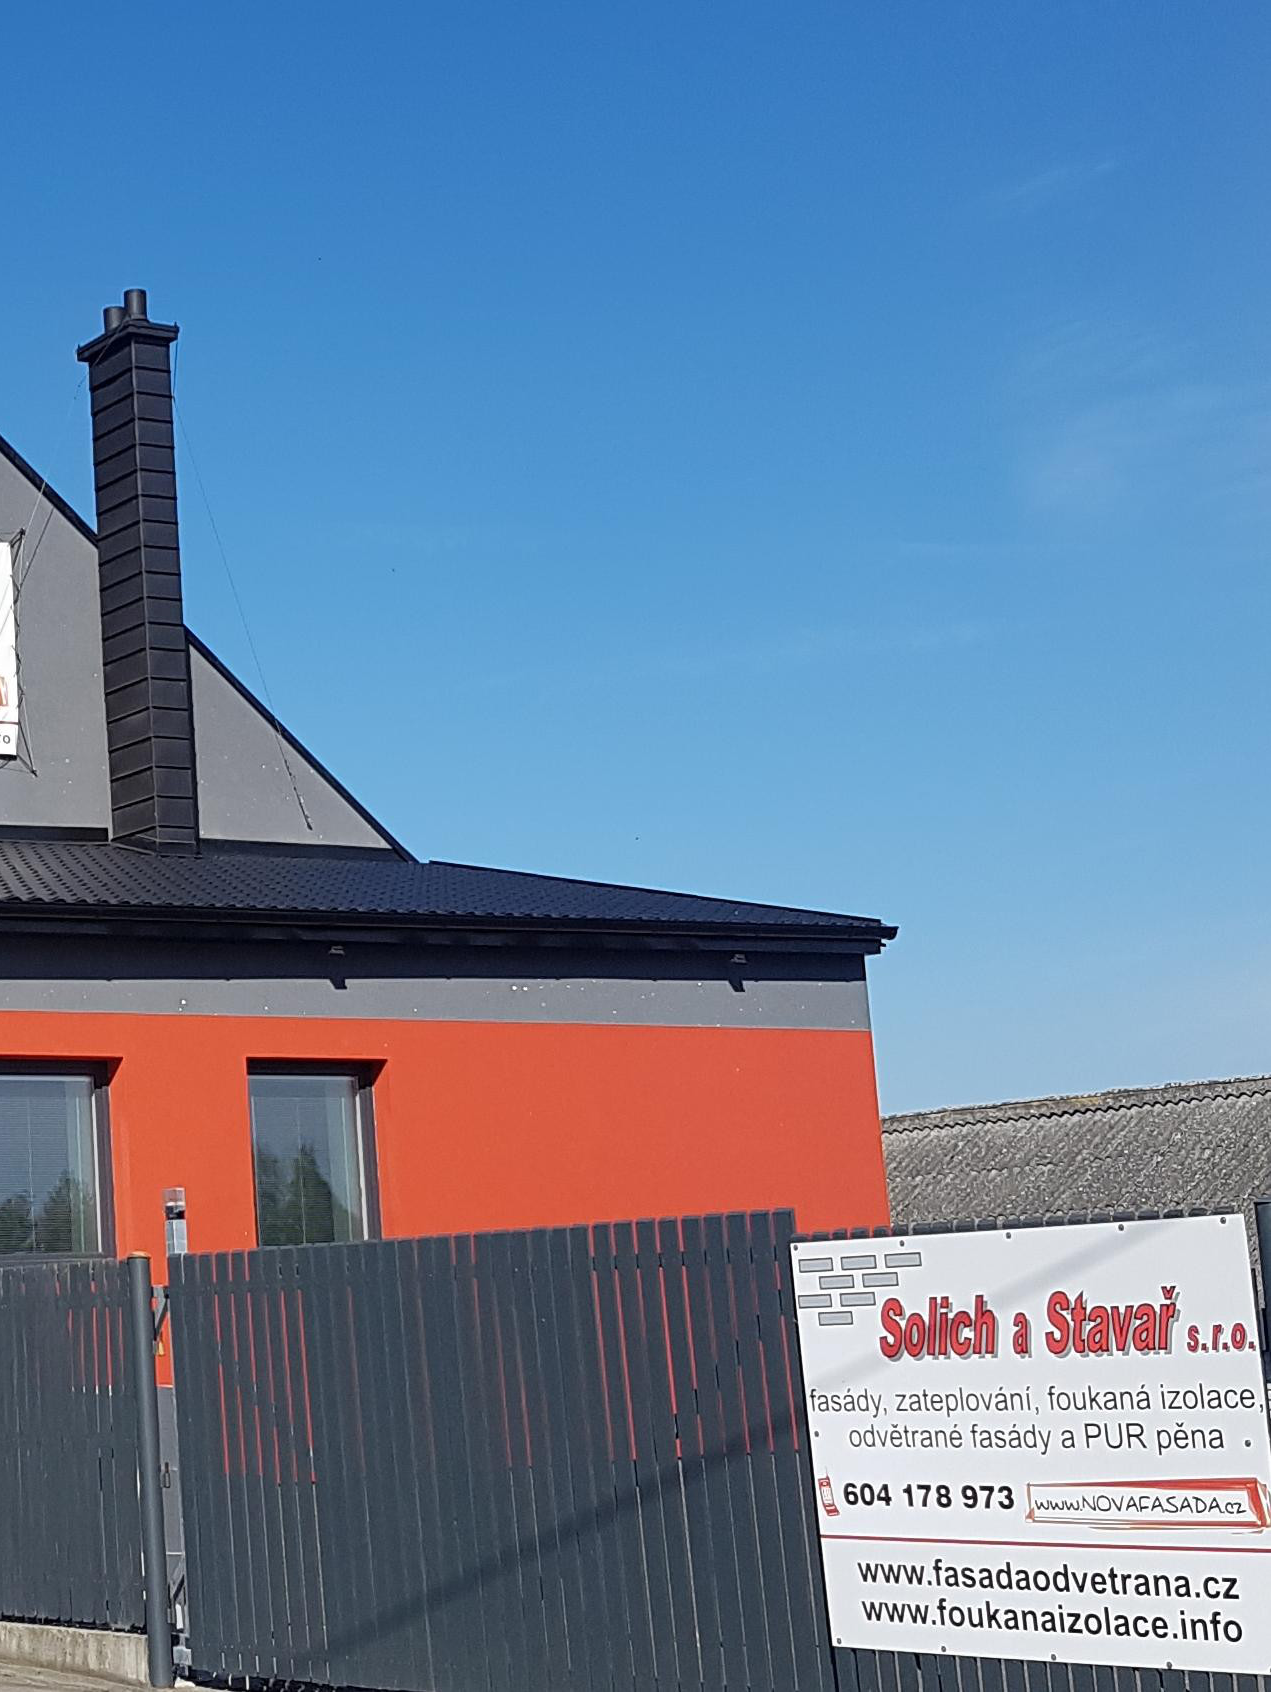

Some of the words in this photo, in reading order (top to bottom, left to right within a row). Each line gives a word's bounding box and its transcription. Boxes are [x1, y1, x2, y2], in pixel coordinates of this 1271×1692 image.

[879, 1295, 996, 1358] Solich
[1013, 1312, 1029, 1355] a
[1045, 1285, 1179, 1357] Stavař
[1186, 1322, 1256, 1352] s.r.o.
[810, 1389, 888, 1418] fasády,
[895, 1387, 1041, 1417] zateplování,
[1047, 1386, 1151, 1411] foukaná
[1159, 1383, 1264, 1413] izolace,
[849, 1423, 963, 1449] odvětrané
[970, 1426, 1052, 1455] fasády
[1060, 1431, 1076, 1449] a
[1085, 1424, 1147, 1449] PUR
[1156, 1423, 1224, 1455] pěna
[843, 1483, 892, 1506] 604
[902, 1483, 952, 1508] 178
[960, 1485, 1015, 1509] 973
[1035, 1495, 1247, 1514] www.NOVAFASADA.cz
[857, 1560, 1240, 1600] www.fasadaodvetrana.cz
[861, 1598, 1244, 1643] www.foukanaizolace.info
